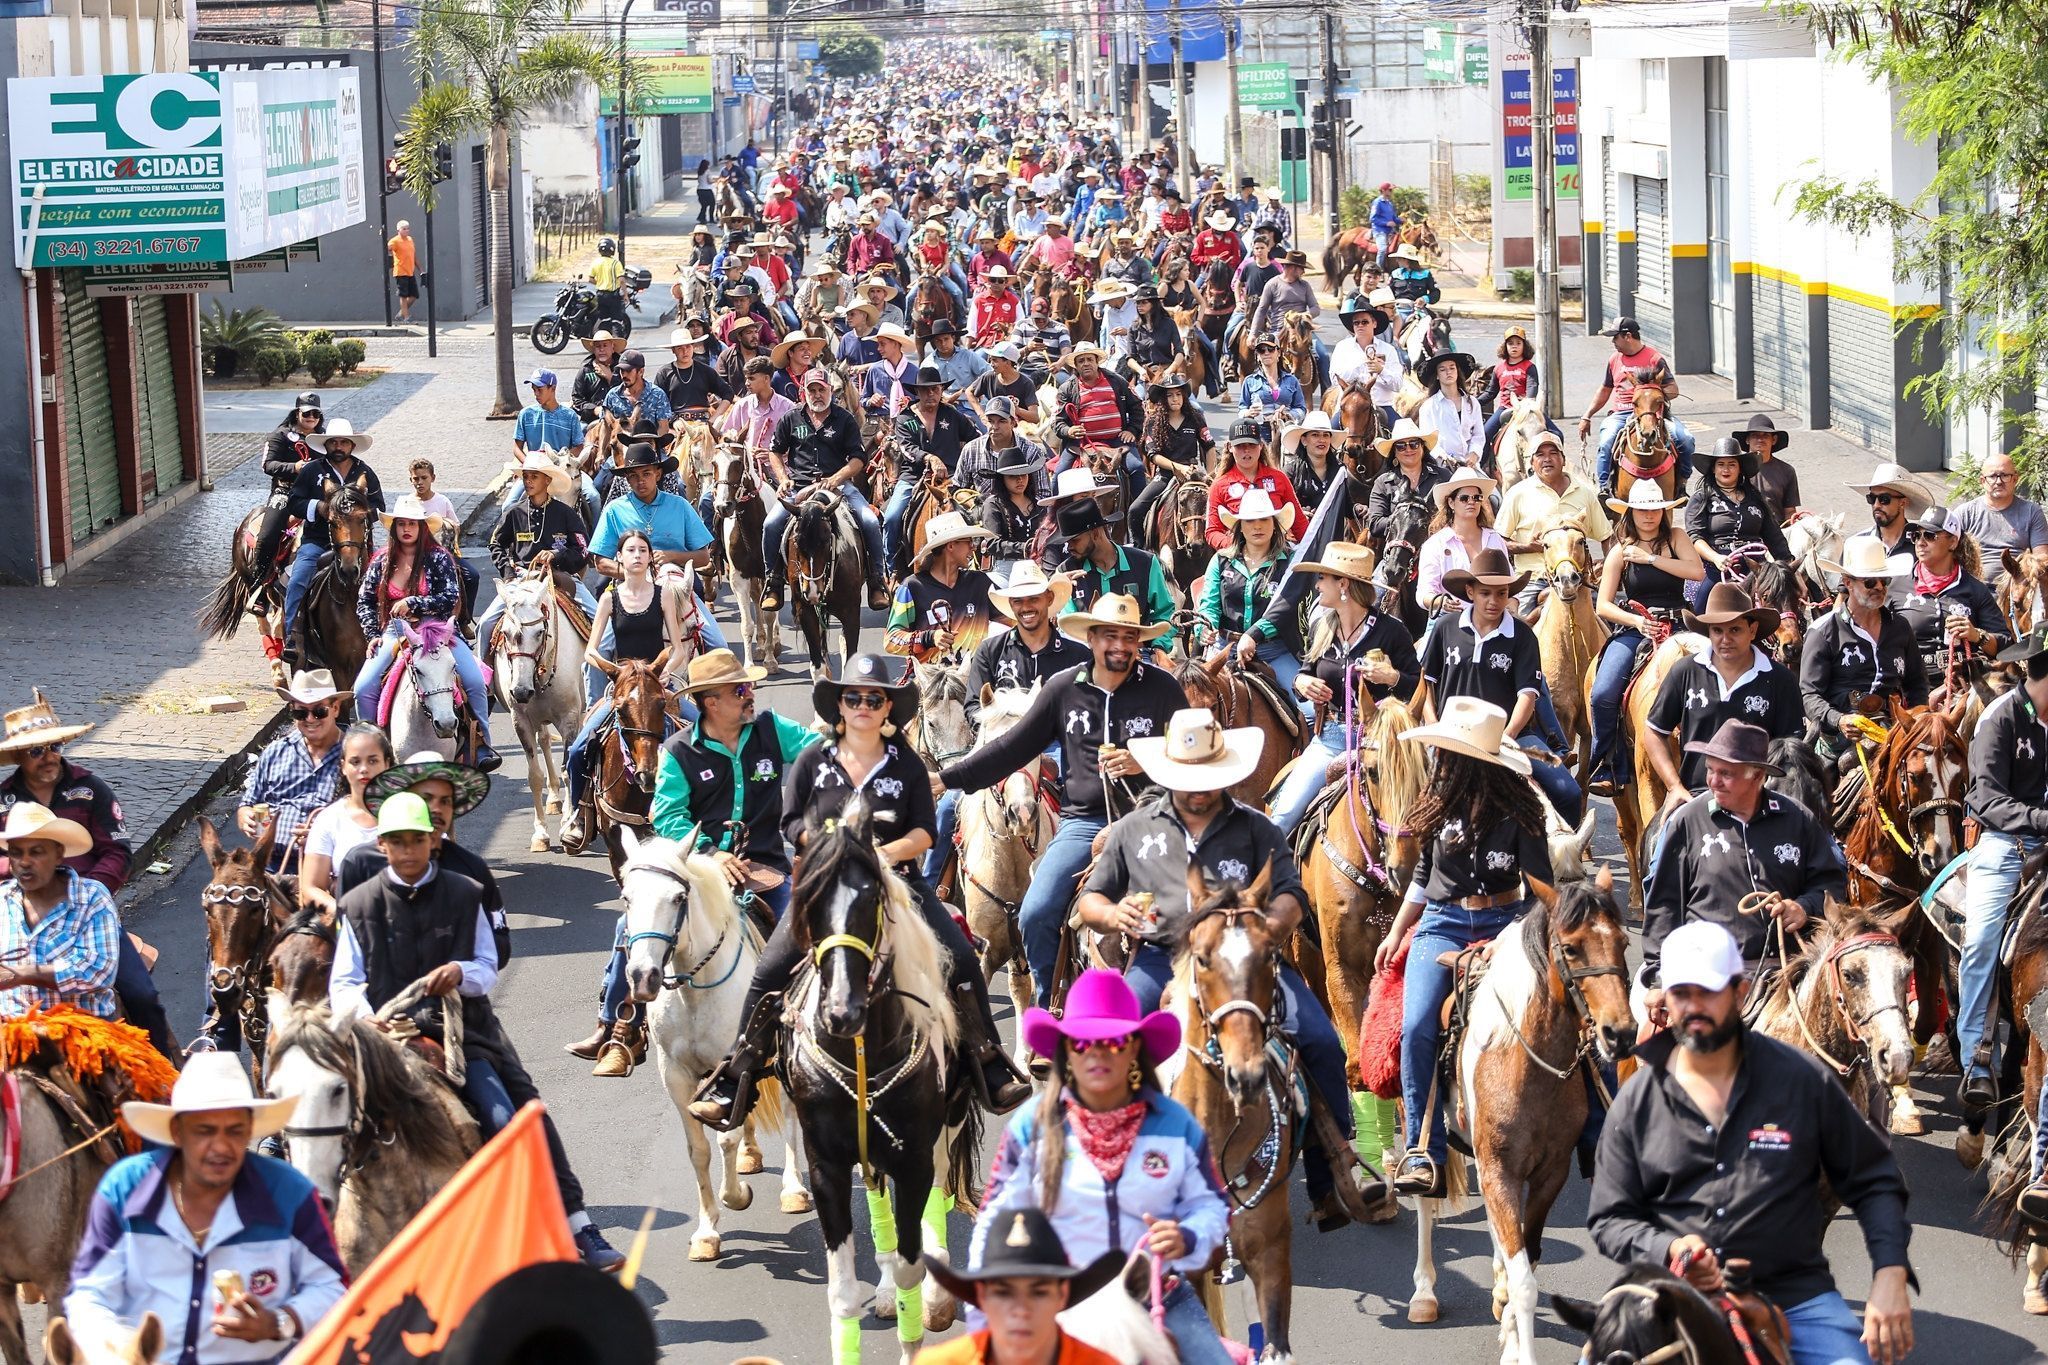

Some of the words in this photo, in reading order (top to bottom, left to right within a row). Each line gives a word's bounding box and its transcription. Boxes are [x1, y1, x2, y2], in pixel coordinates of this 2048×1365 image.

[186, 182, 220, 191] ILUMINAÇÃO
[98, 209, 132, 220] com
[139, 200, 219, 217] economia
[48, 241, 88, 261] (34)
[94, 236, 201, 255] 3221.6767
[107, 285, 143, 293] Telefax:
[164, 282, 209, 290] 3221.6767
